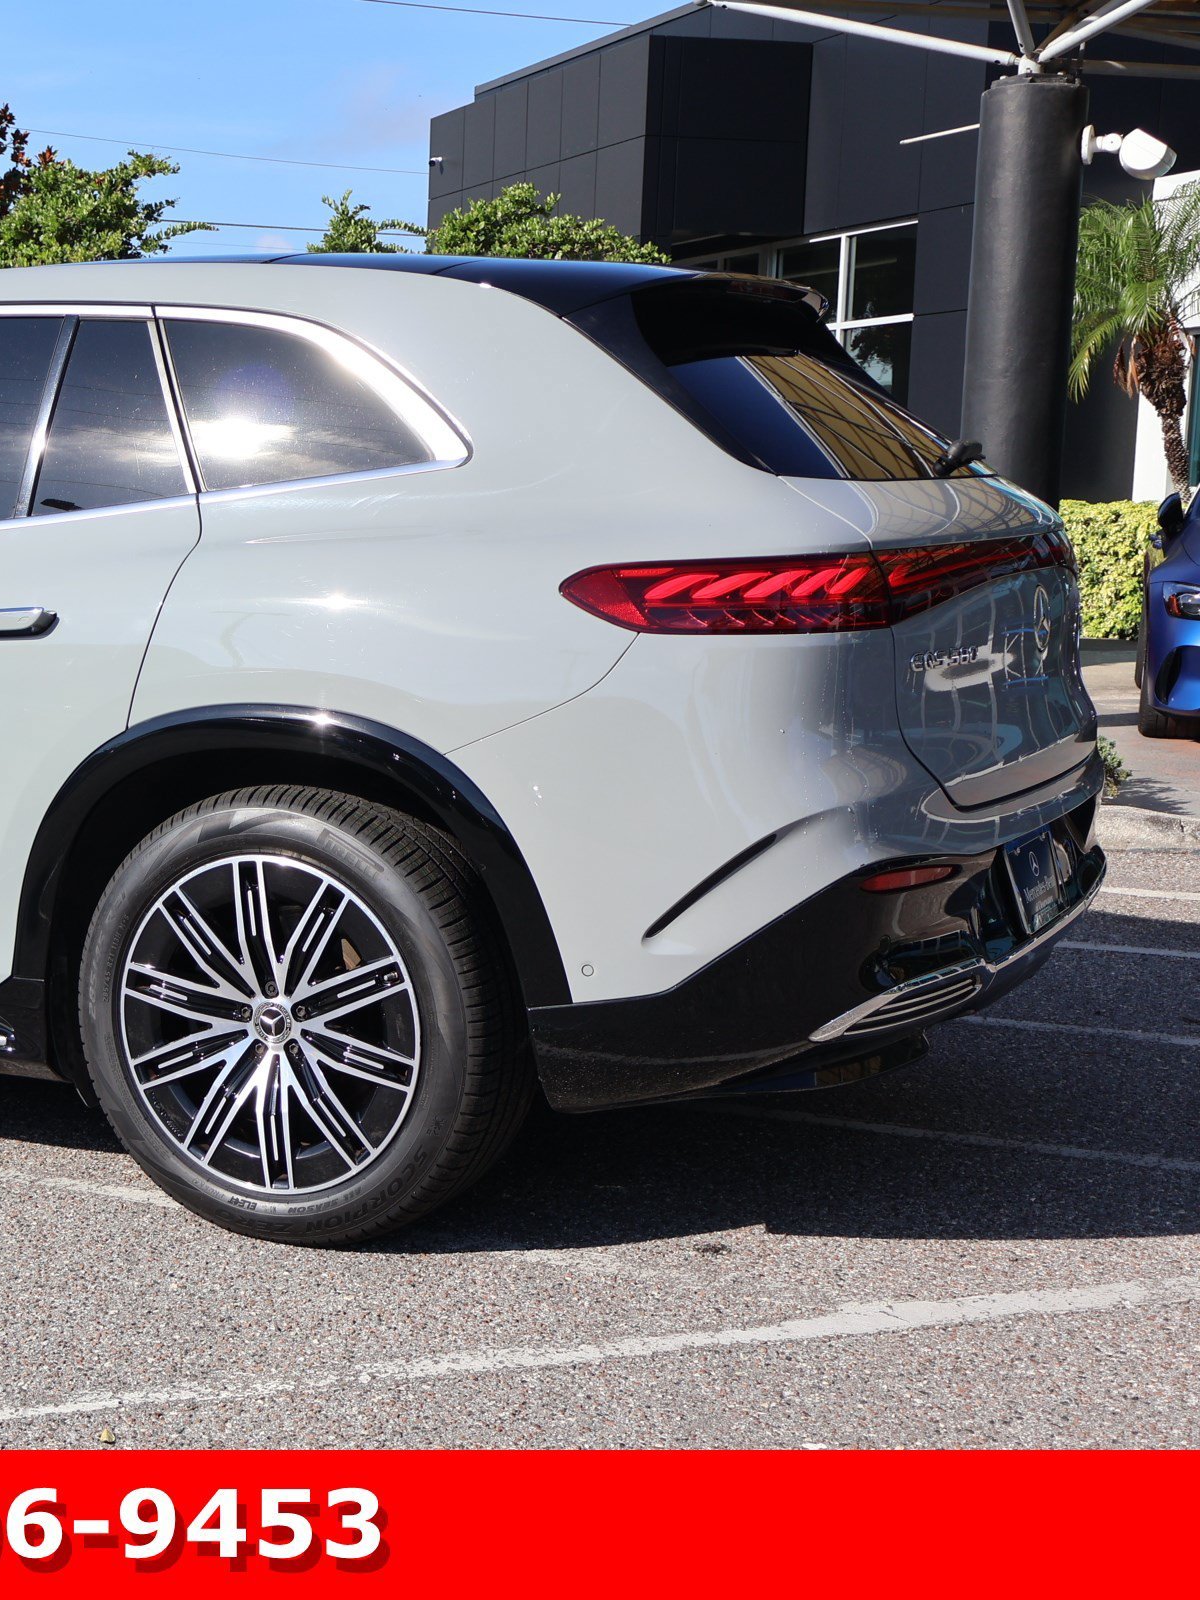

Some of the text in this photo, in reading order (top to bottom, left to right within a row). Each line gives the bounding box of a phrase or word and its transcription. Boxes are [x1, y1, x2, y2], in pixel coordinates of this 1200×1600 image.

[910, 645, 979, 672] EQS 580
[305, 1144, 428, 1233] SCORPION
